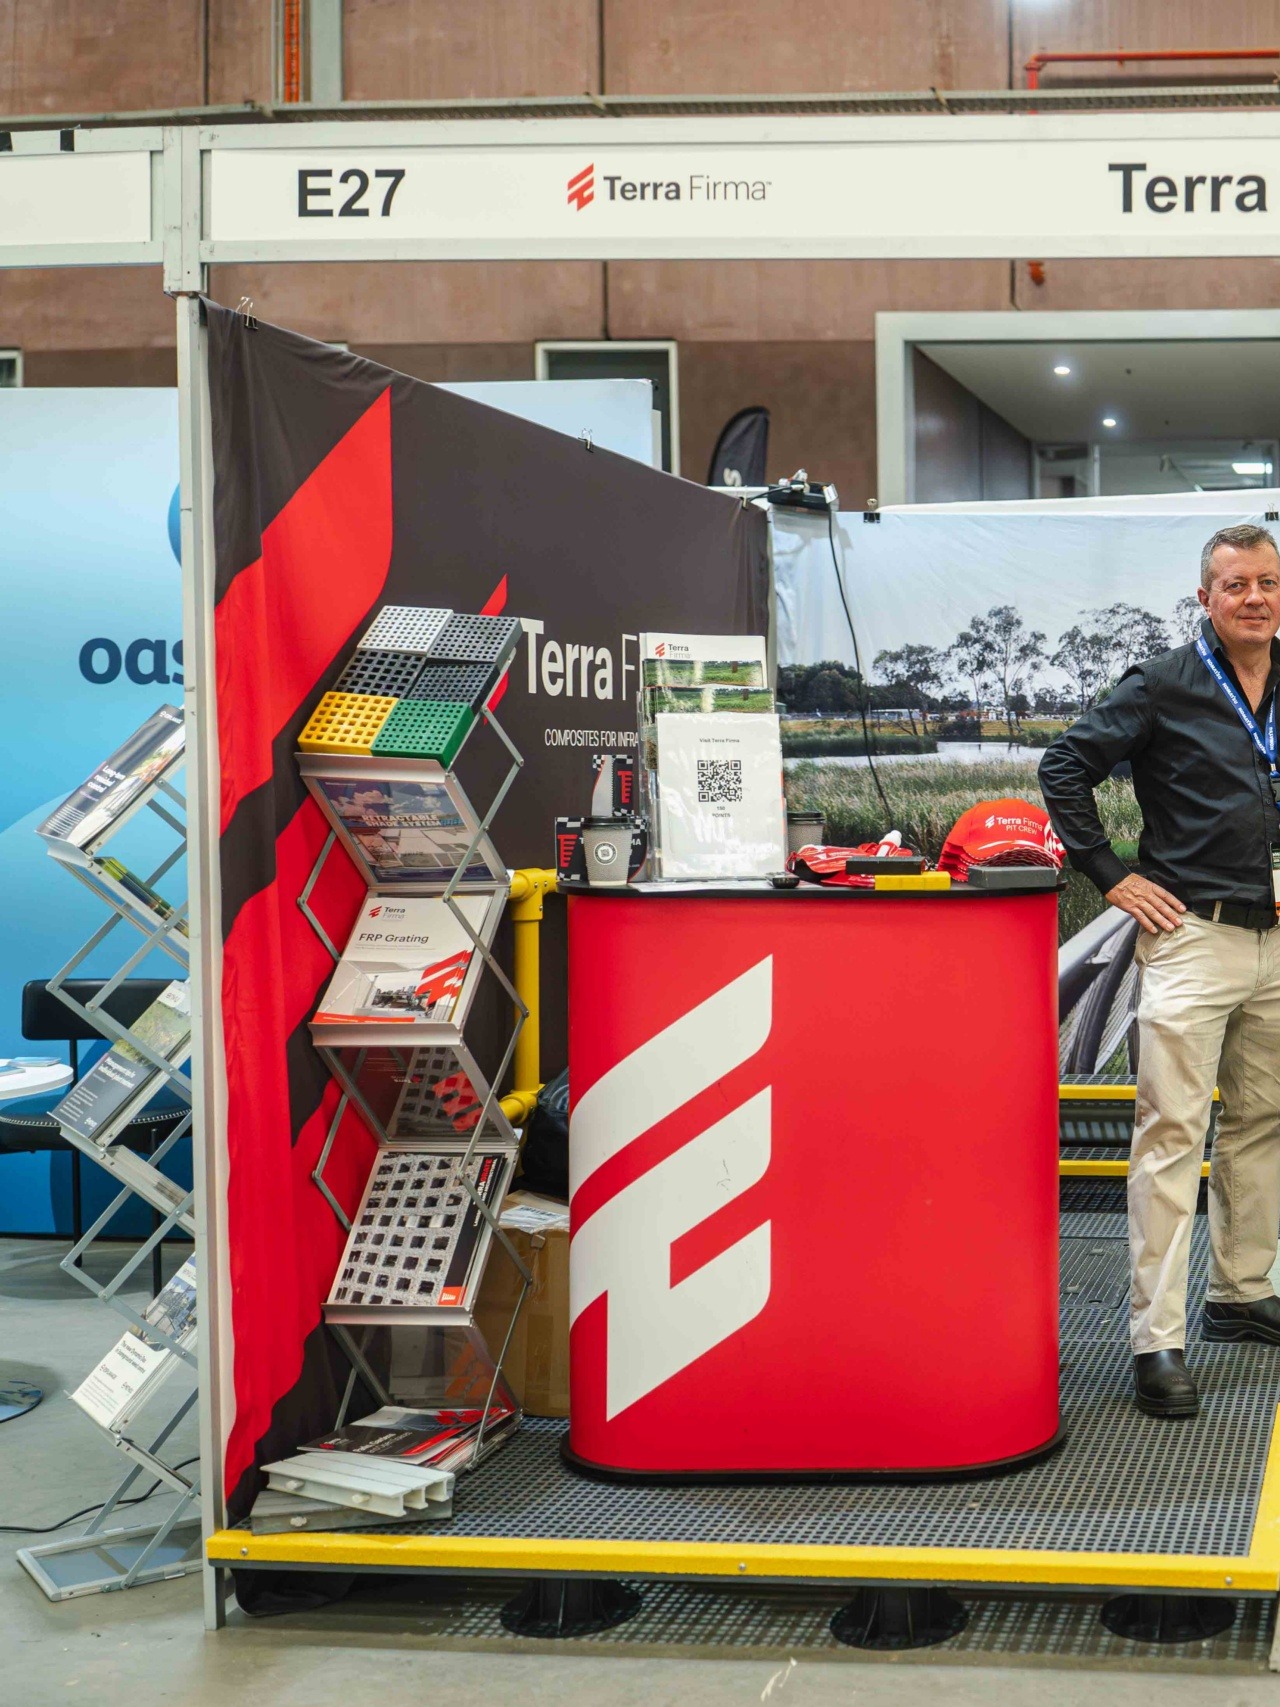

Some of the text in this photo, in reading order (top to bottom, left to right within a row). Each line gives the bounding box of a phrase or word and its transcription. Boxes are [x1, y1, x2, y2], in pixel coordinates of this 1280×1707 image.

[298, 168, 406, 217] E27
[603, 174, 767, 201] Terra Firma
[1108, 162, 1269, 214] Terra
[668, 643, 689, 652] Terra
[520, 617, 614, 701] Terra
[1206, 658, 1222, 680] KOMATSU
[1222, 683, 1238, 705] KOMATSU
[1238, 707, 1254, 729] KOMATSU
[544, 728, 600, 747] COMPOSITES
[600, 730, 617, 747] FOR
[361, 814, 437, 823] RETRACTABLE
[996, 816, 1043, 832] Terra Firma
[1006, 824, 1037, 835] PIT CREW
[384, 906, 406, 914] Terra
[358, 933, 429, 945] FRP Grating
